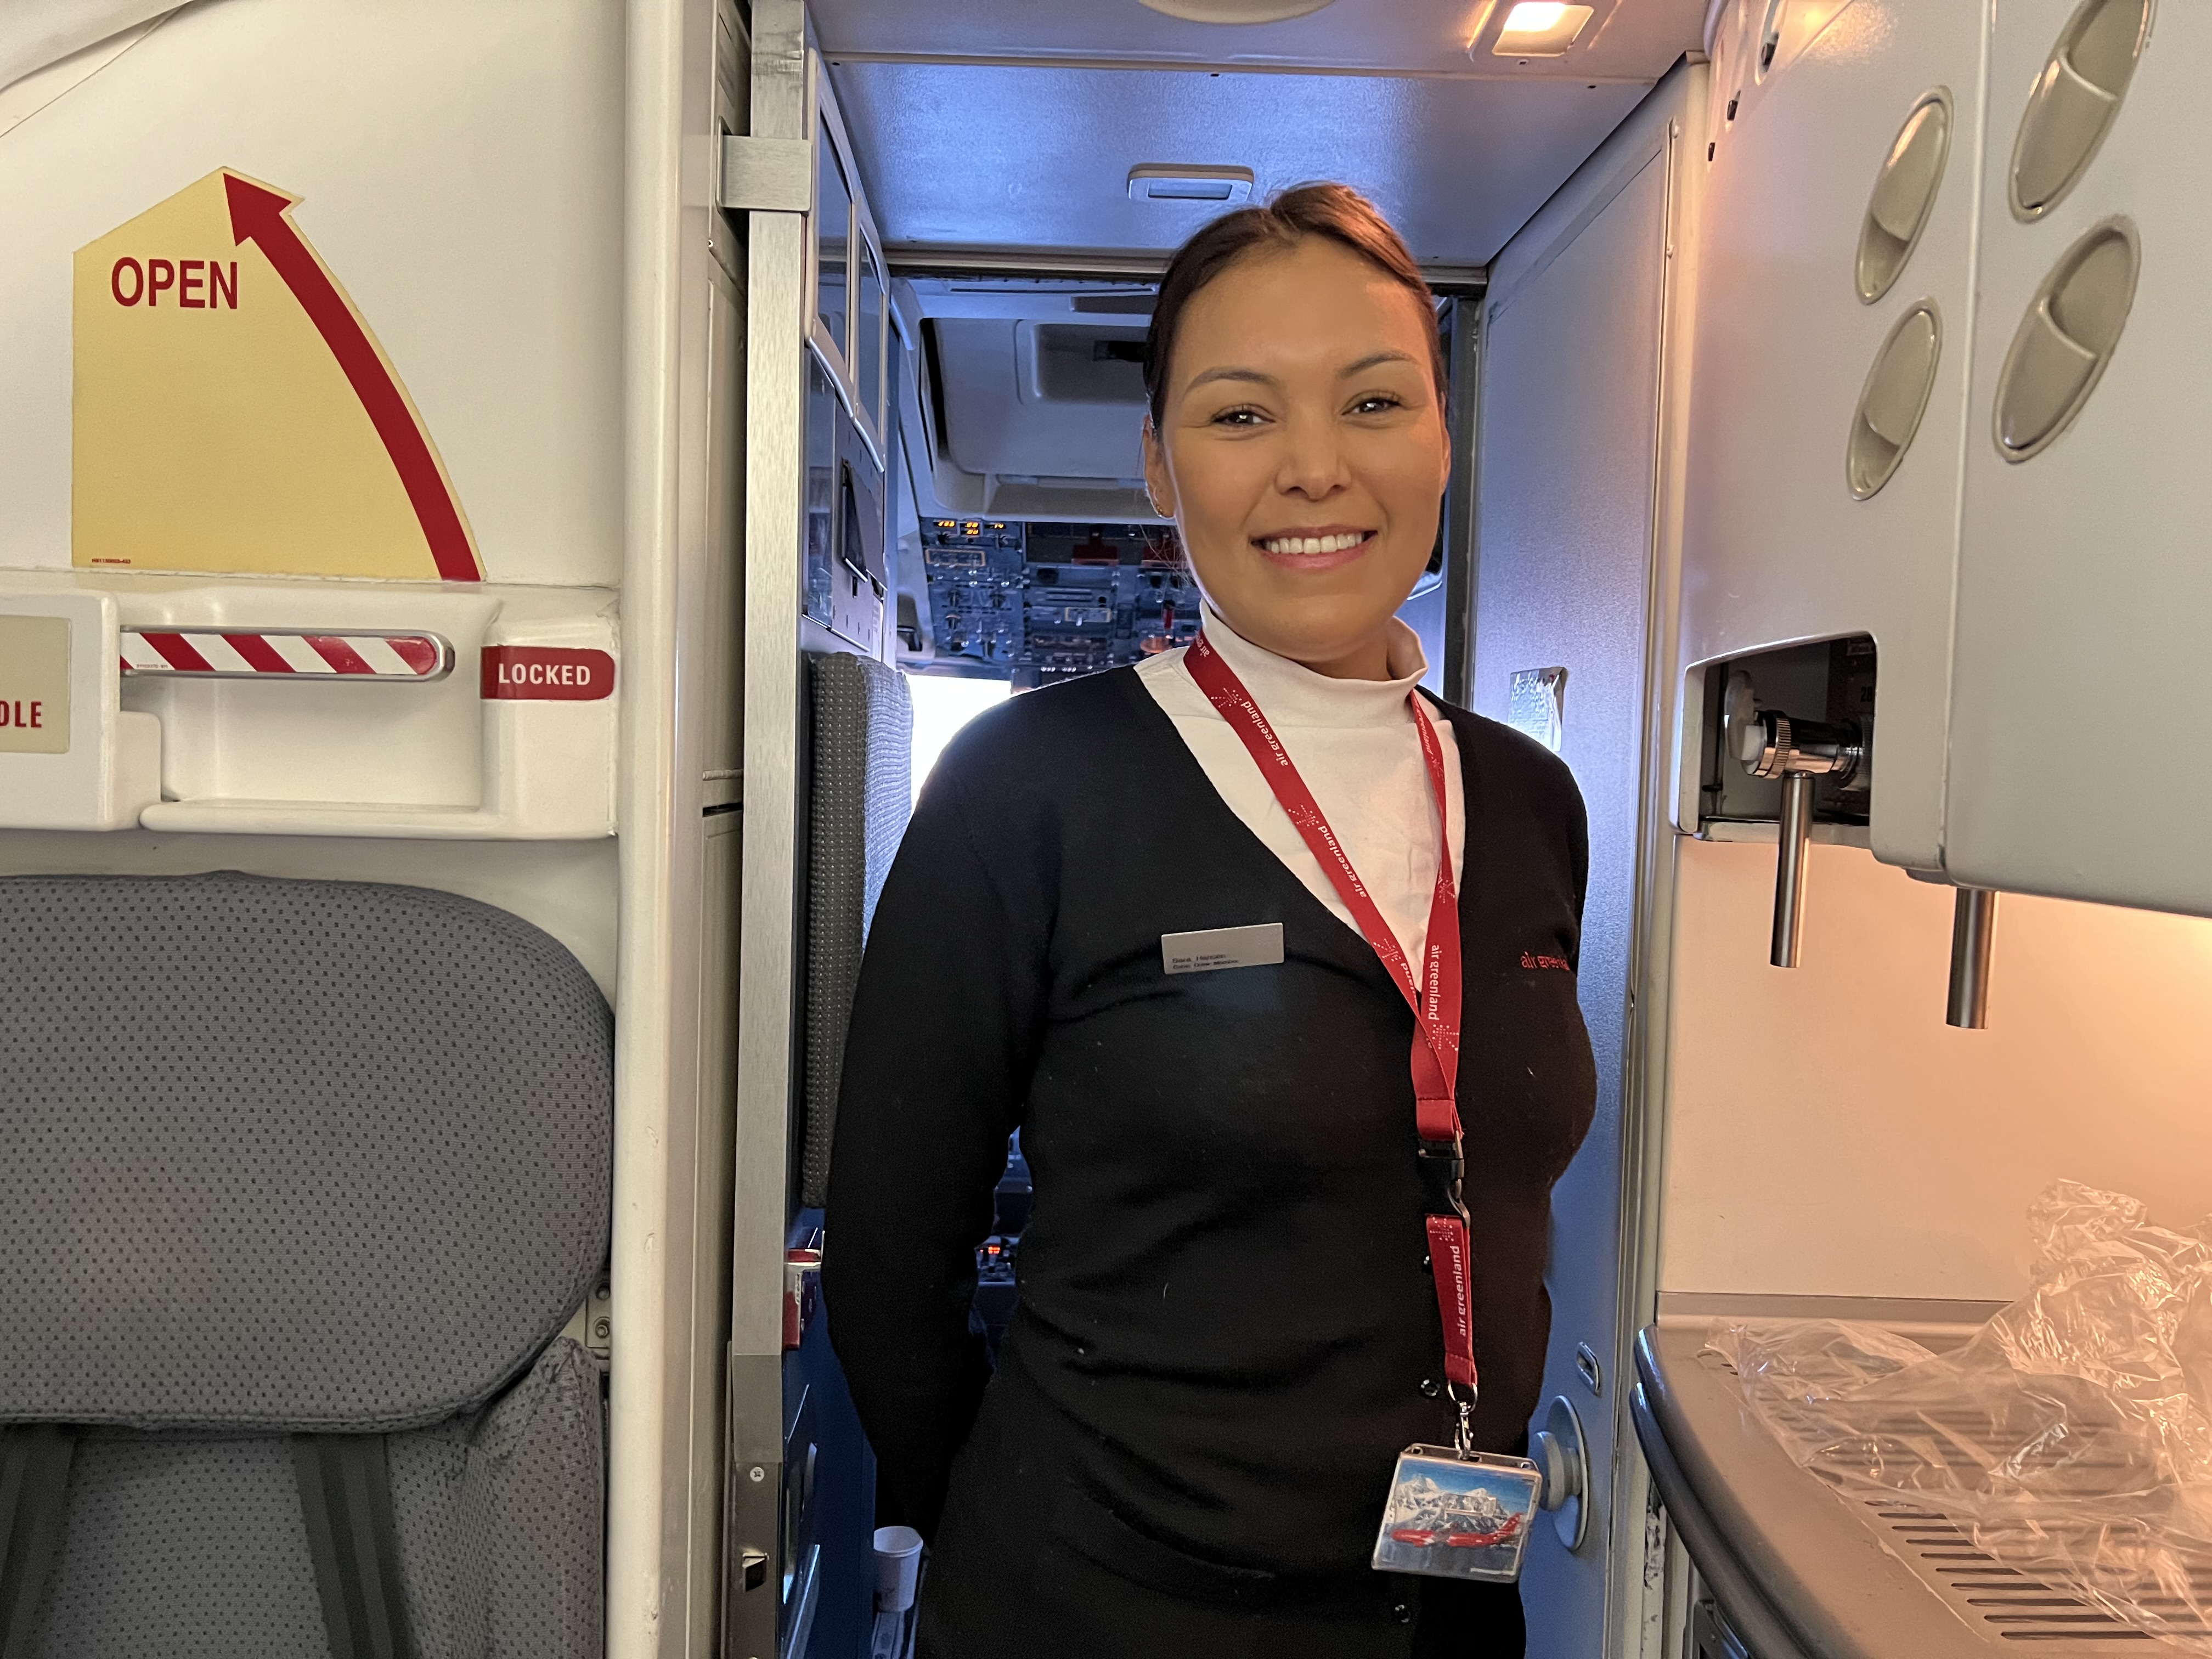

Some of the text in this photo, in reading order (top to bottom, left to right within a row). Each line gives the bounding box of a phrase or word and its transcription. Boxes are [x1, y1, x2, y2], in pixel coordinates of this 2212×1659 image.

[111, 256, 238, 309] OPEN
[498, 663, 591, 686] LOCKED
[1240, 701, 1288, 766] air greenland
[1318, 825, 1367, 898] air greenland
[1428, 944, 1442, 1020] air greenland
[1520, 951, 1538, 969] air
[1449, 1245, 1466, 1336] air greenland
